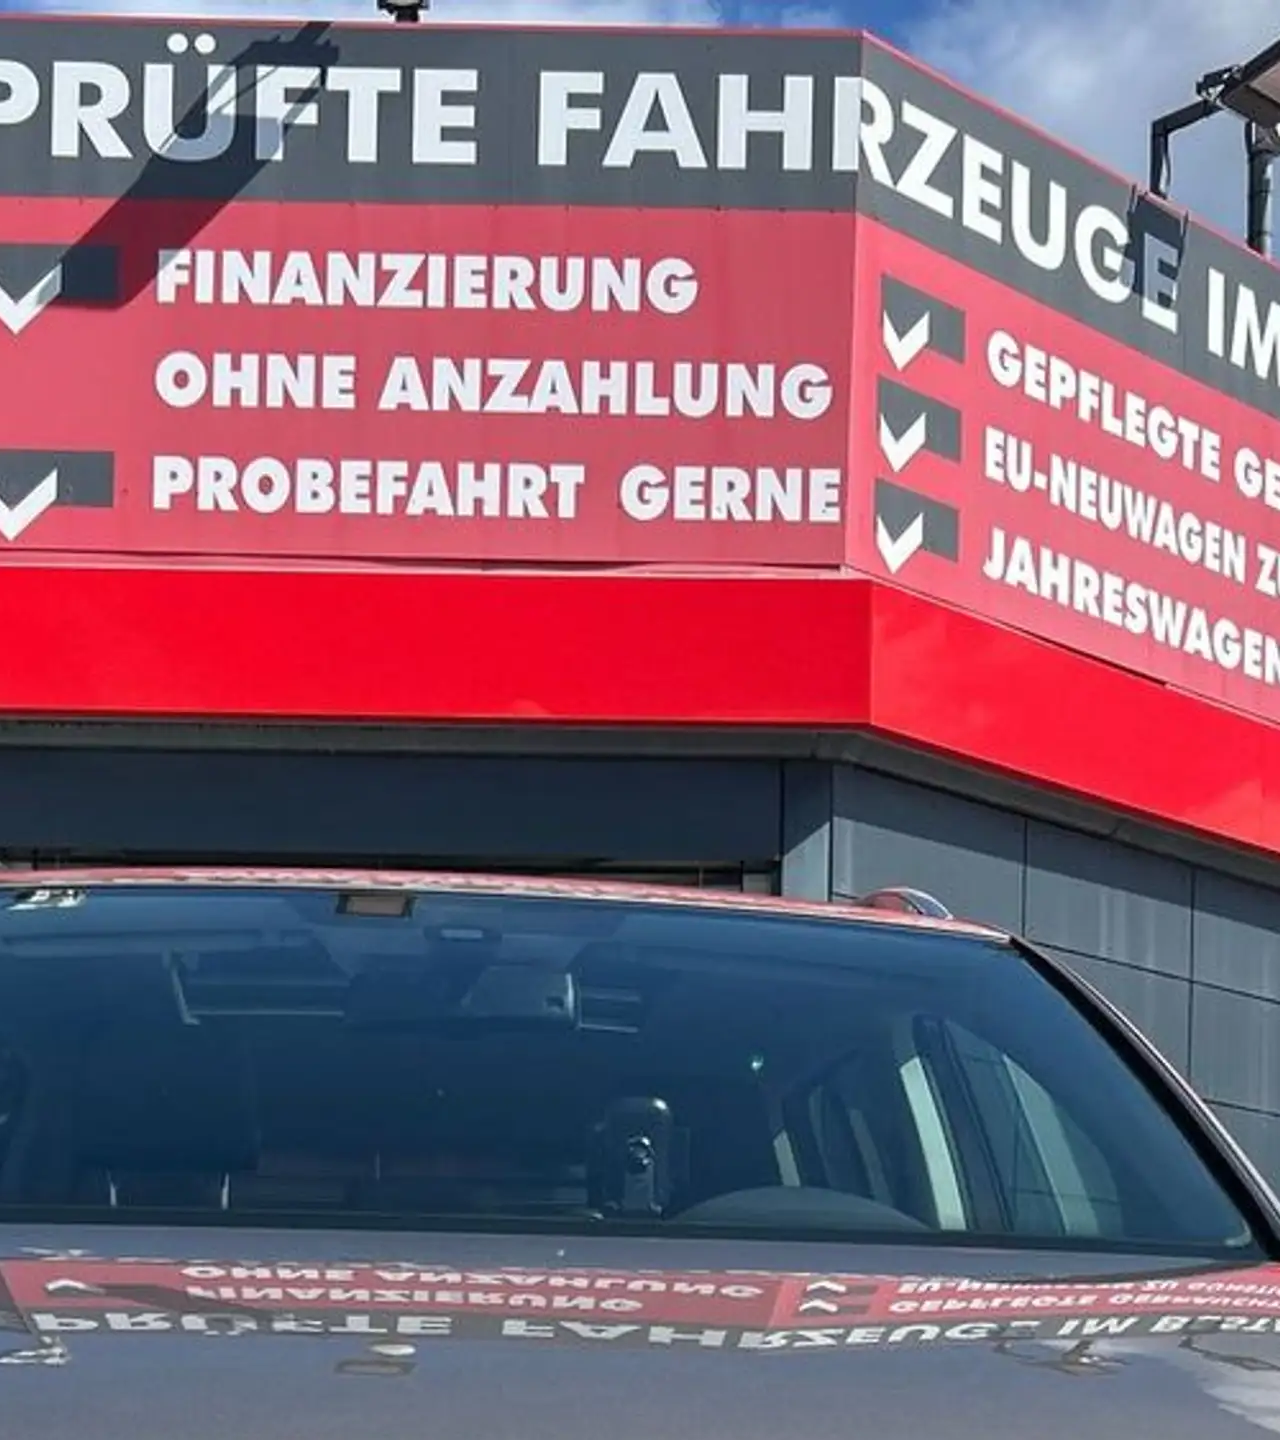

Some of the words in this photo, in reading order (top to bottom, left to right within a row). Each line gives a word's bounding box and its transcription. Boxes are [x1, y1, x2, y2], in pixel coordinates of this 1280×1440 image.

[537, 70, 1178, 333] FAHRZEUGE
[158, 249, 698, 314] FINANZIERUNG
[155, 351, 356, 409] OHNE
[378, 356, 833, 419] ANZAHLUNG
[986, 331, 1220, 481] GEPFLEGTE
[153, 456, 585, 518] PROBEFAHRT
[621, 465, 840, 523] GERNE
[984, 426, 1245, 581] EU-NEUWAGEN
